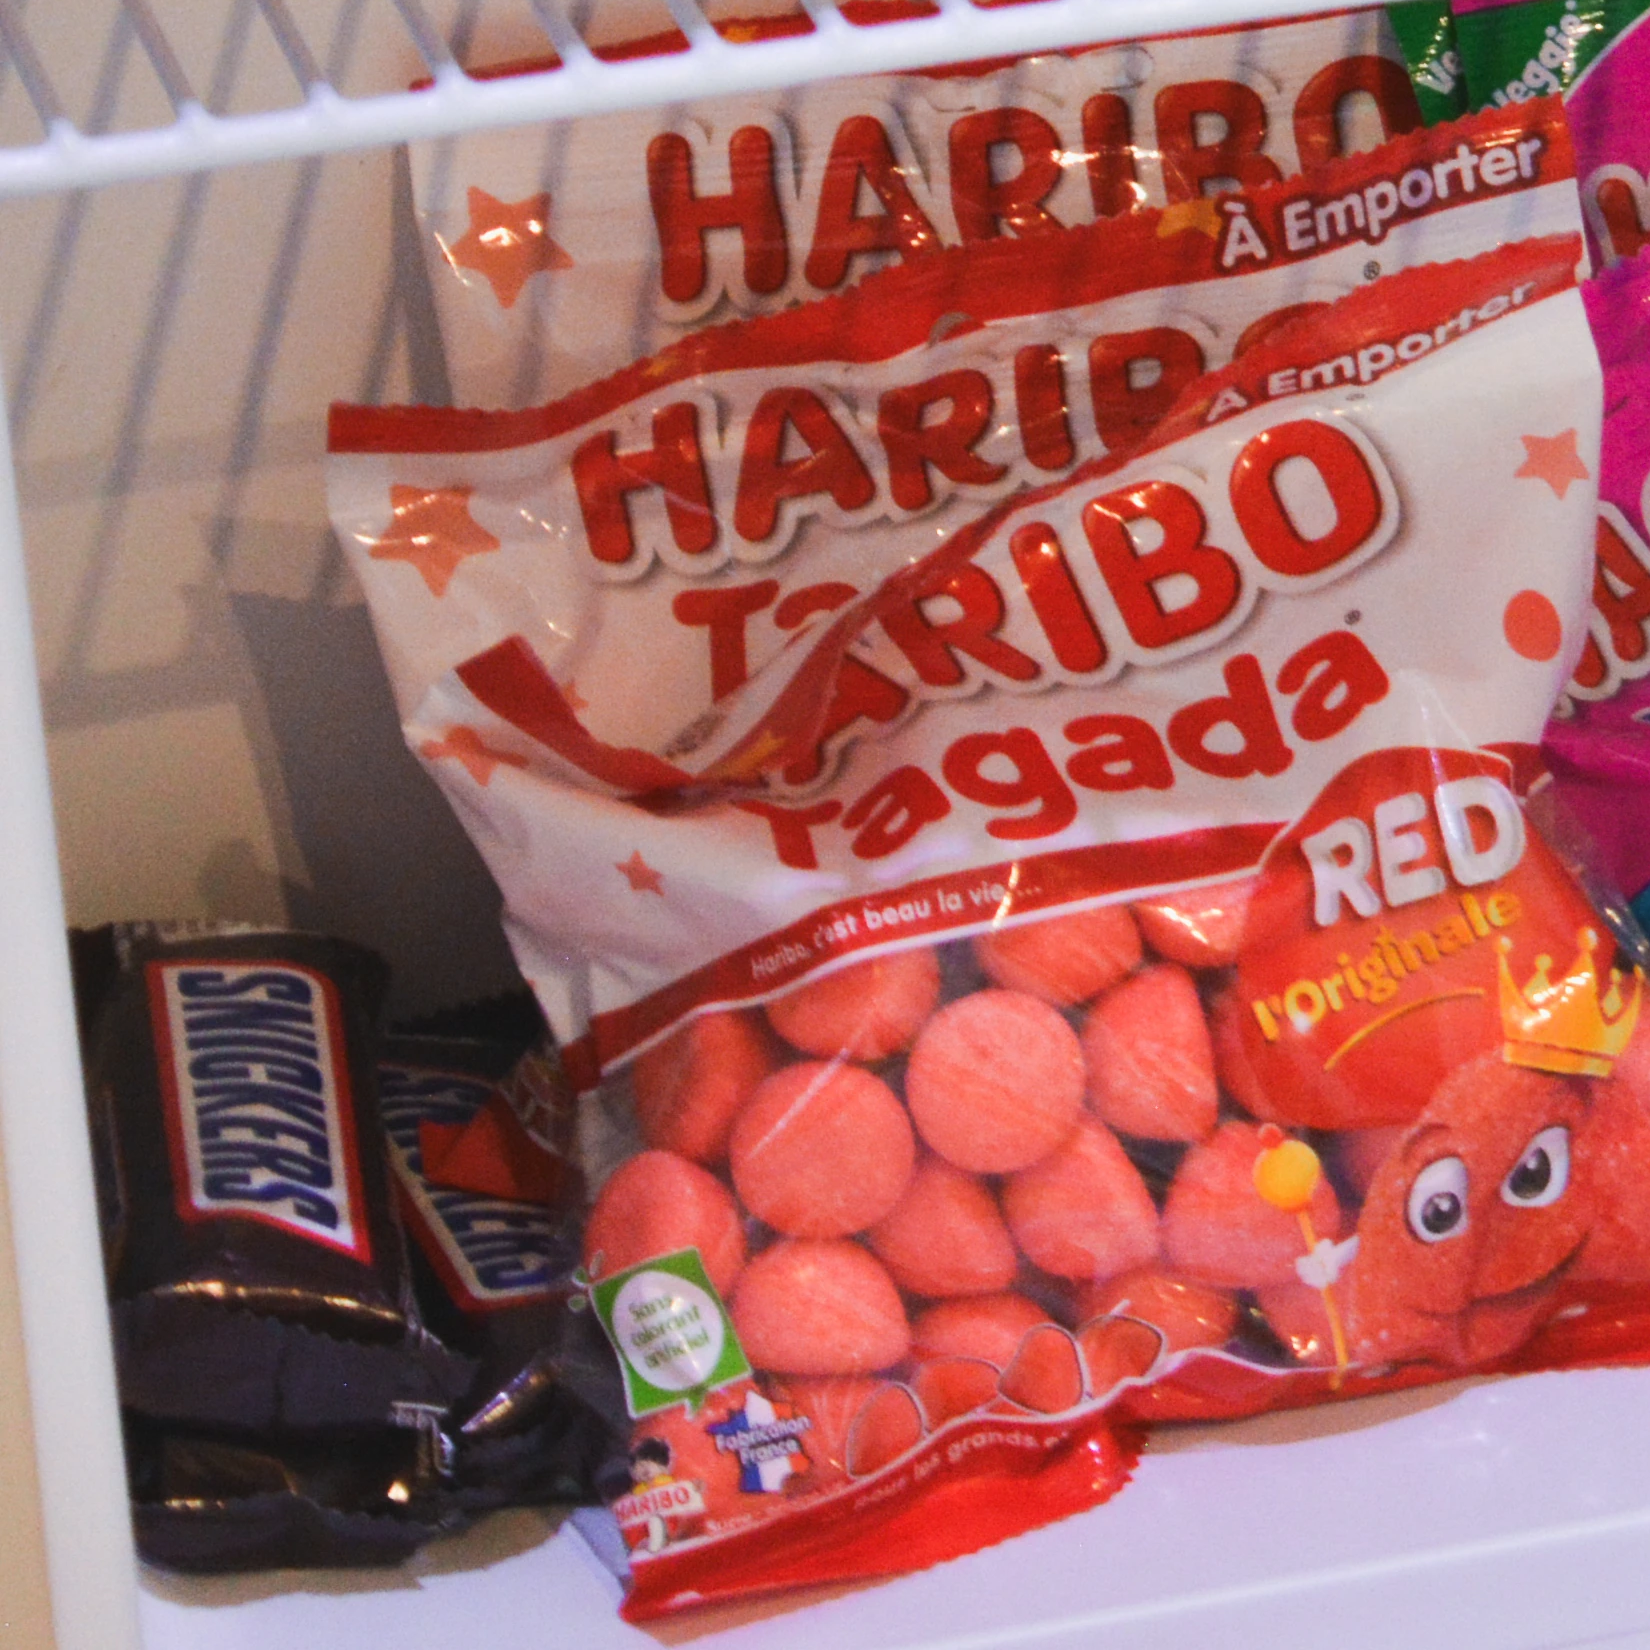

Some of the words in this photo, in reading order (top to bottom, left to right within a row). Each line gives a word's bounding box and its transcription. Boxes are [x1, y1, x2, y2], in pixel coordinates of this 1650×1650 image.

[1221, 202, 1268, 268] À
[1283, 135, 1544, 246] Emporter
[1267, 277, 1540, 400] Emporter
[571, 301, 1333, 564] HARIB
[734, 629, 1391, 870] Tagada
[863, 898, 932, 931] beau
[936, 888, 963, 913] la
[1301, 774, 1527, 928] RED
[1251, 888, 1523, 1044] l'Originale
[176, 970, 340, 1233] SNICKERS
[948, 1429, 1039, 1465] grands
